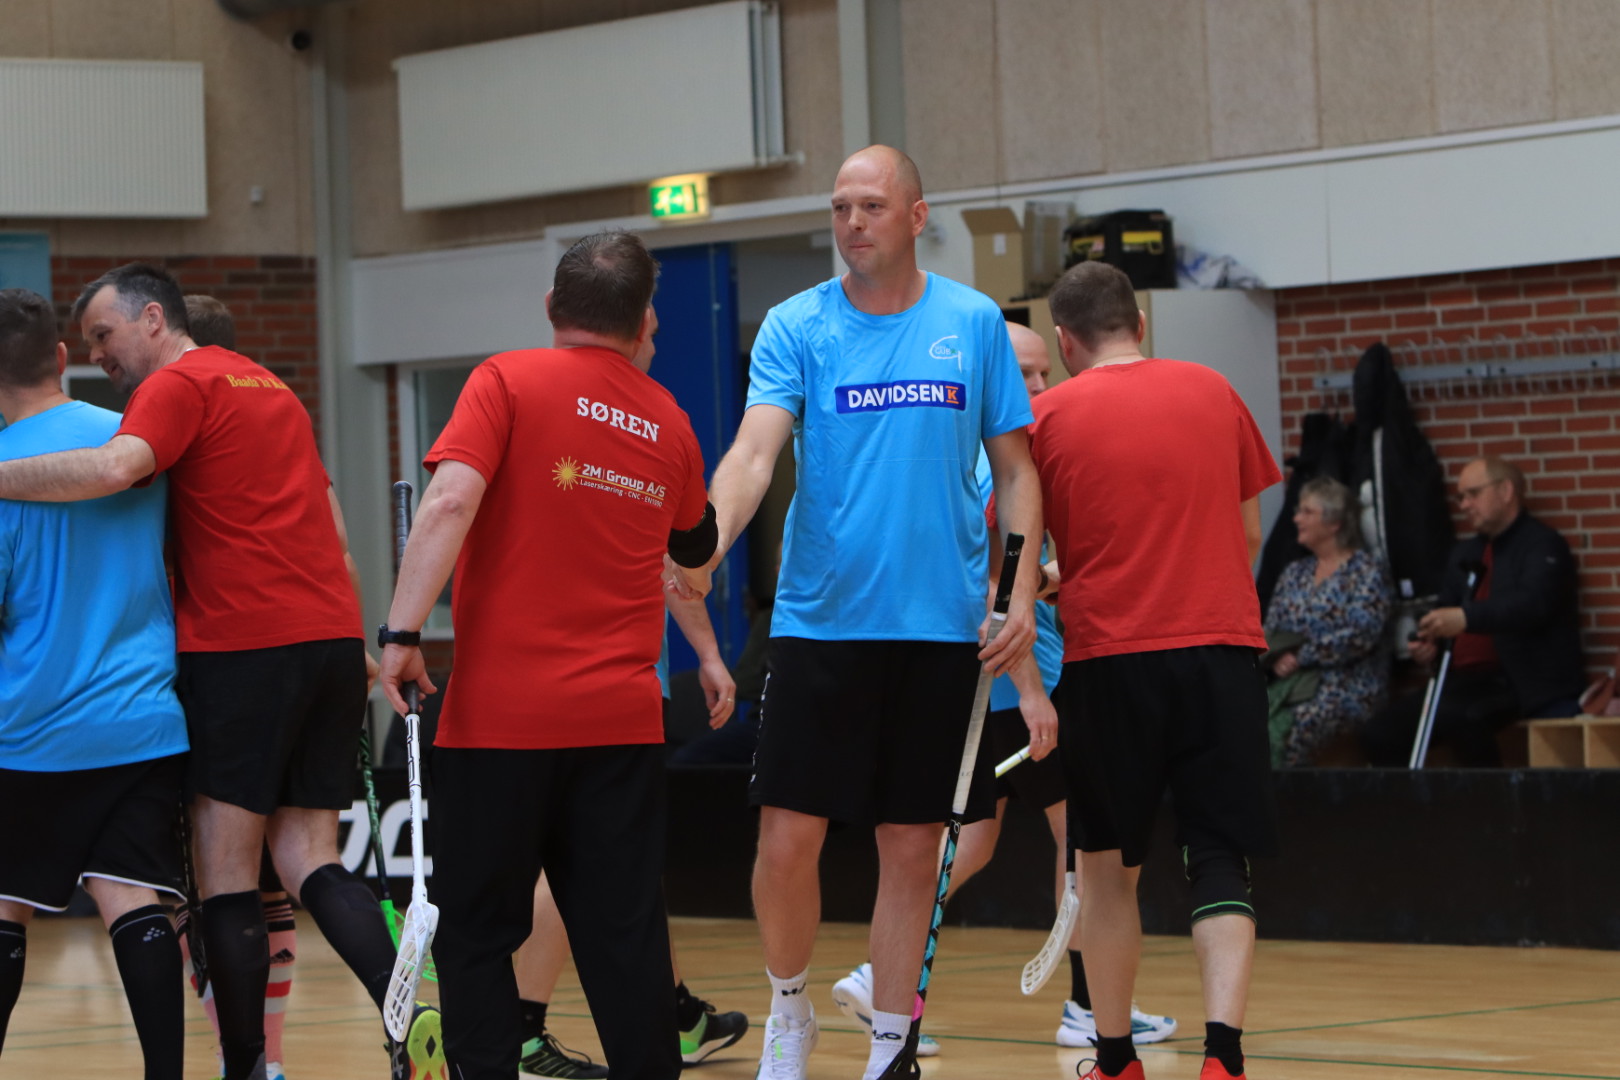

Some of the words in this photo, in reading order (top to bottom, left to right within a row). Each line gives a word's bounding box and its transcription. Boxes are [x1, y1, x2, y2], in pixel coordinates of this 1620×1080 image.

[847, 384, 945, 408] DAVIDSEN
[576, 396, 660, 442] SØREN
[581, 463, 602, 479] 2M
[606, 469, 645, 491] Group
[646, 482, 667, 498] A/S
[627, 491, 641, 501] CNC
